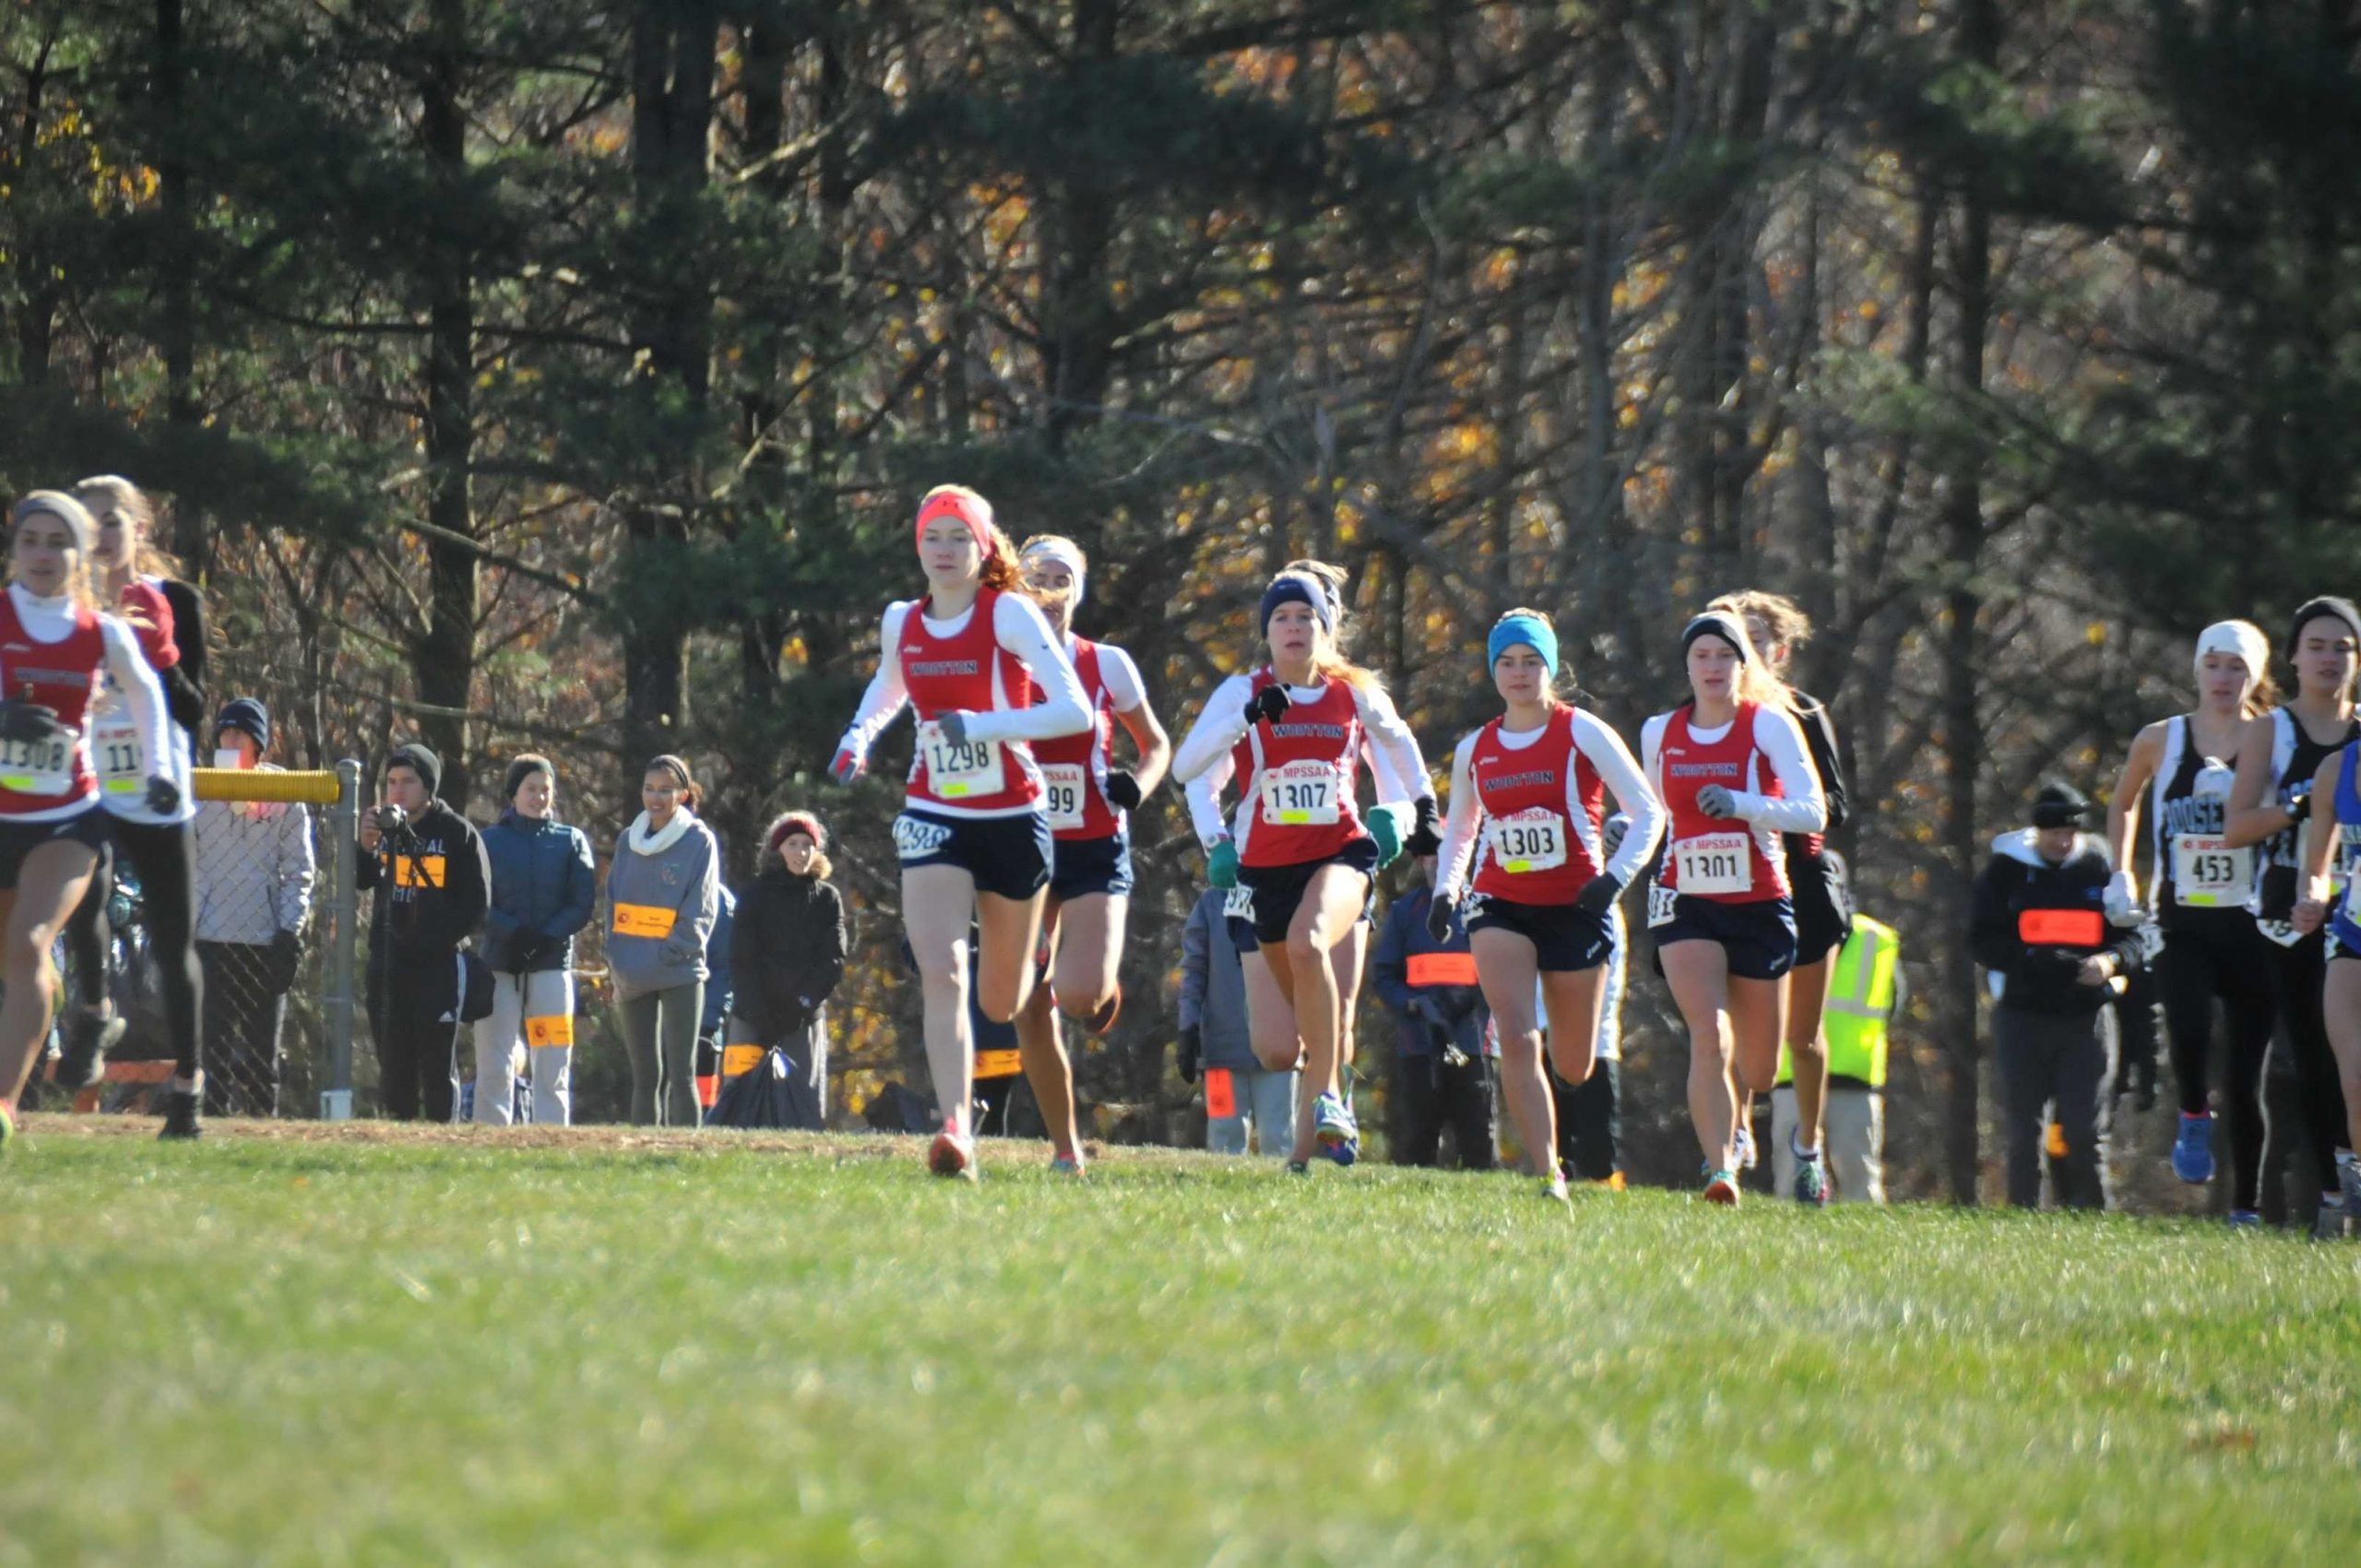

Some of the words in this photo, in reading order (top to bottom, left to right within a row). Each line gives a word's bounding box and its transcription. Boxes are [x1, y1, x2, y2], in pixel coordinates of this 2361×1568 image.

[932, 742, 990, 773] 1298
[1284, 766, 1331, 779] MPSSAA
[1272, 783, 1327, 808] 1307
[1500, 826, 1555, 857] 1303
[1695, 838, 1742, 849] MPSSAA
[1685, 853, 1737, 879] 1301
[2191, 854, 2235, 883] 453
